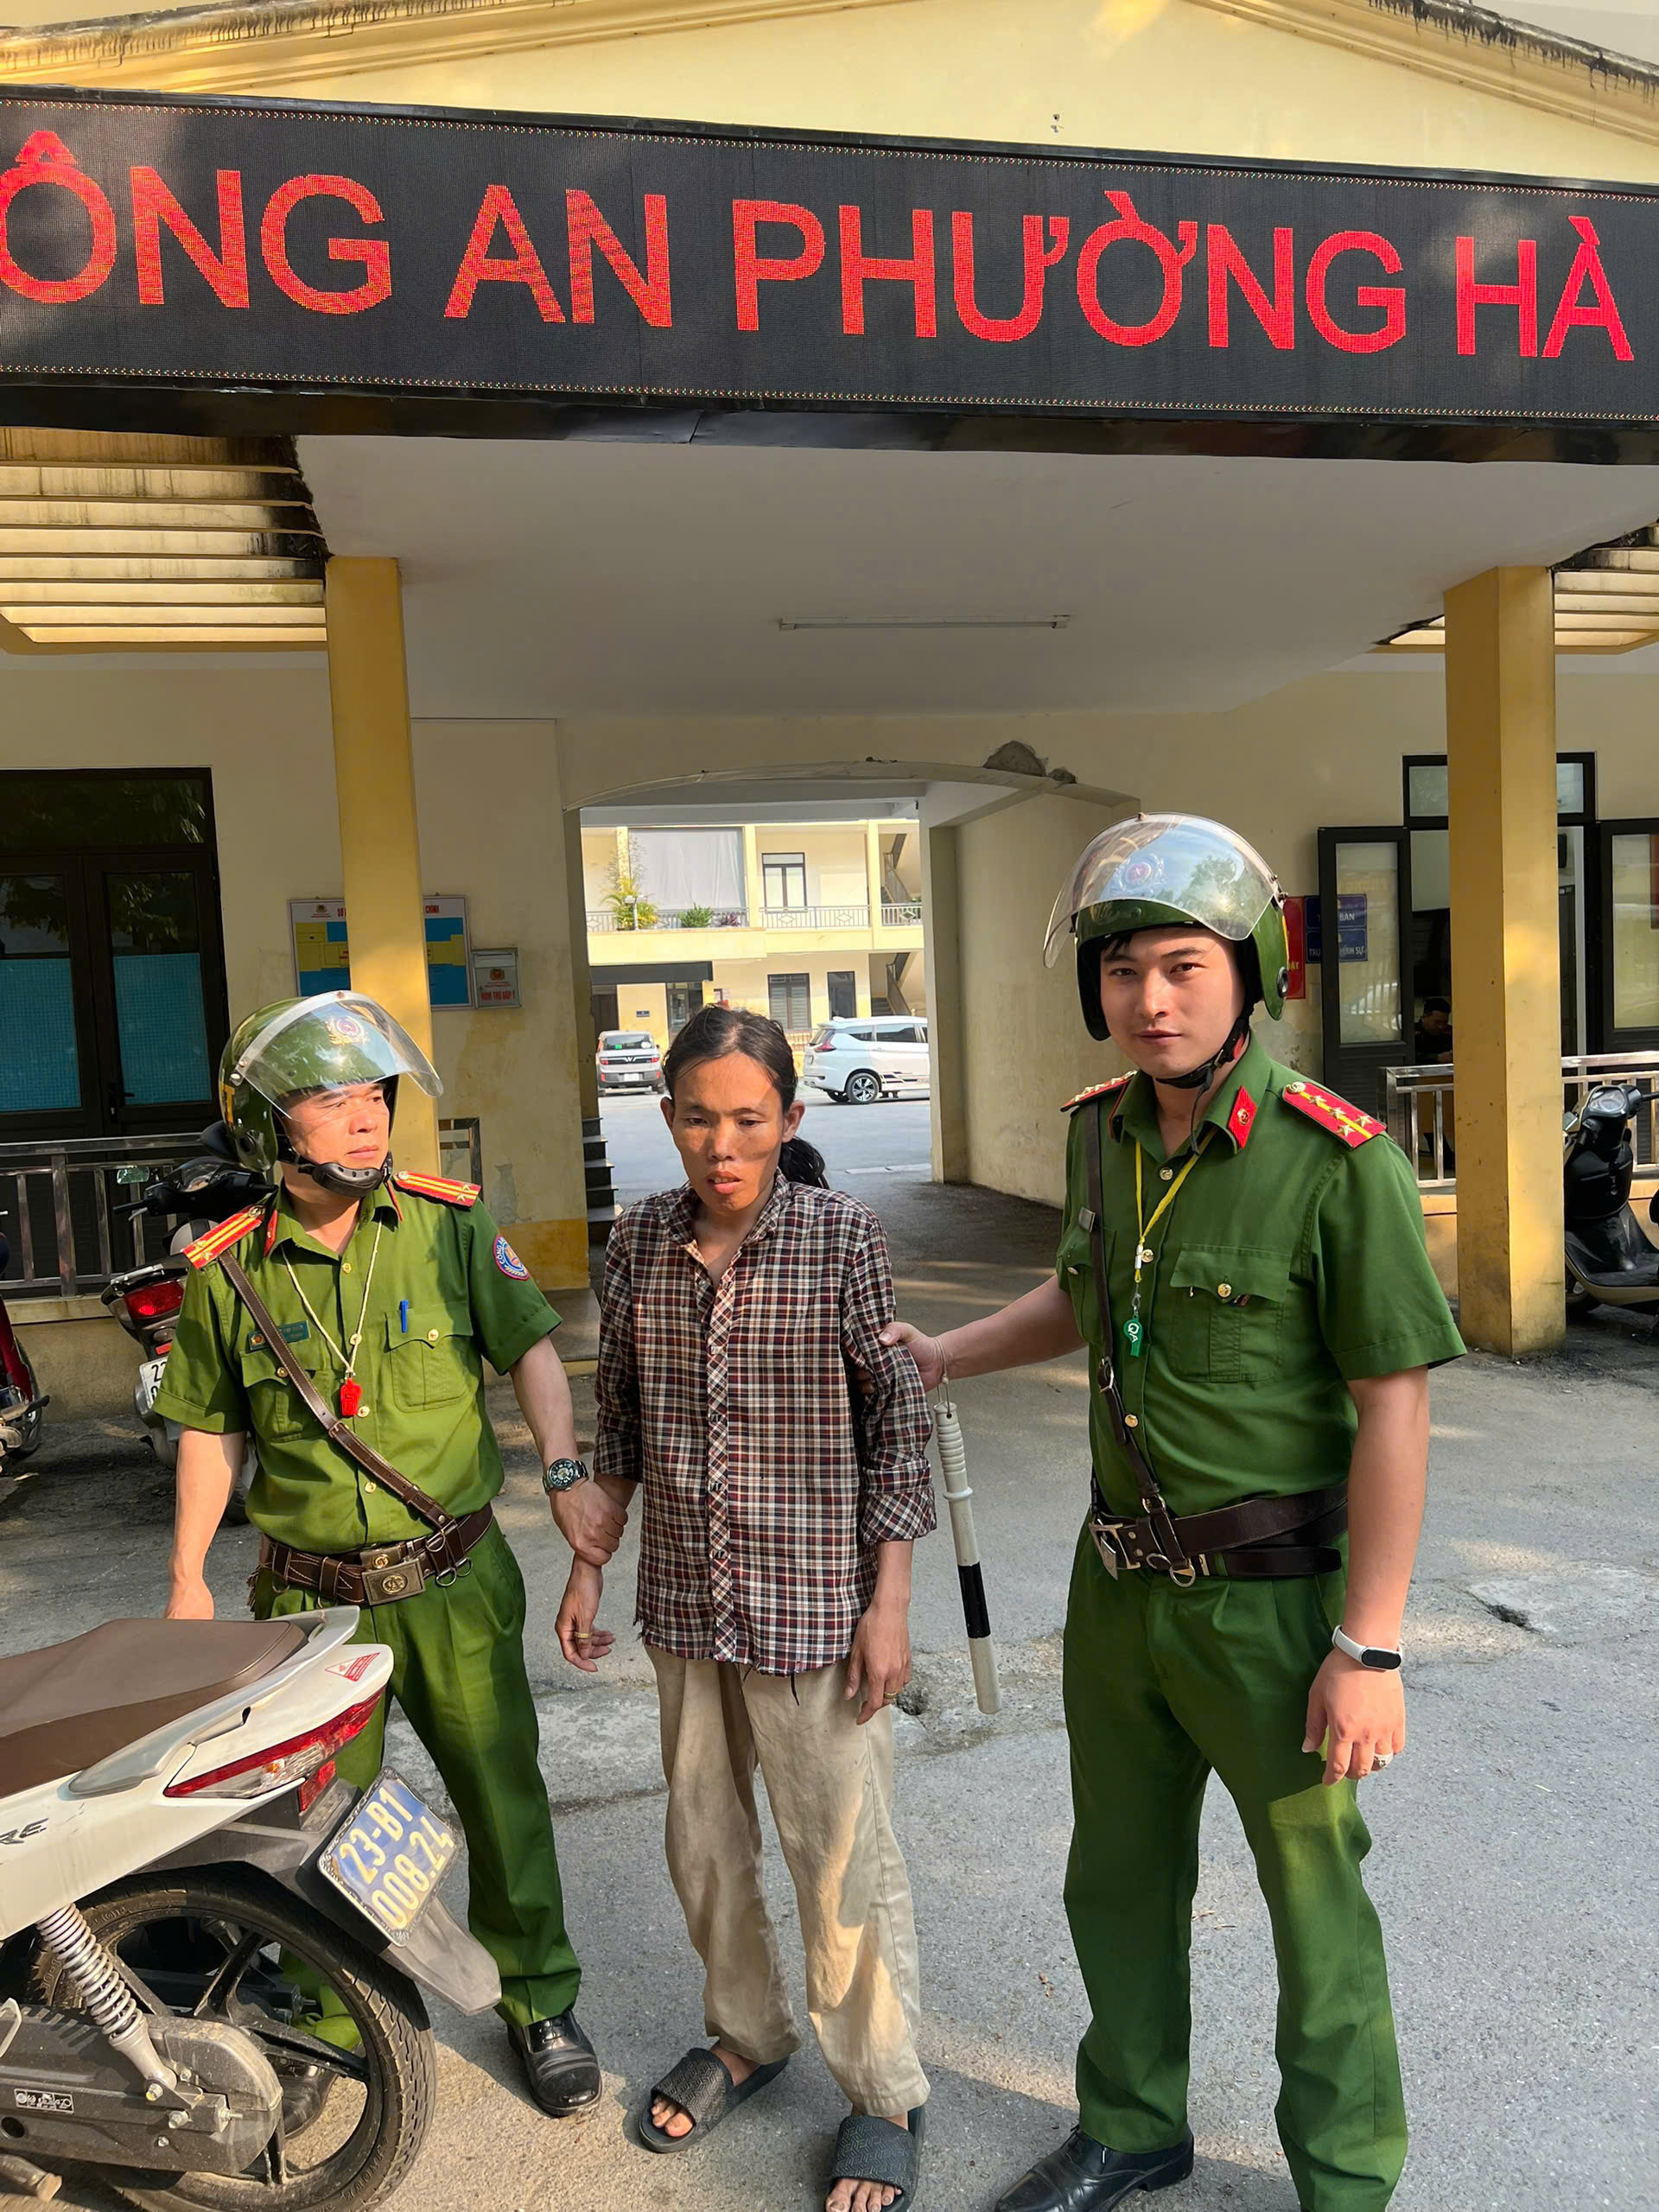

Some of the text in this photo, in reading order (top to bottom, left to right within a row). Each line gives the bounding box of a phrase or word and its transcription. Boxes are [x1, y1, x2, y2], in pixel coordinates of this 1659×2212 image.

[0, 130, 1635, 361] ÔNG AN PHƯỜNG HÀ
[1339, 912, 1355, 921] BAN
[1128, 1323, 1139, 1343] QA
[340, 1786, 413, 1885] 23-B1
[372, 1815, 455, 1929] 008.24
